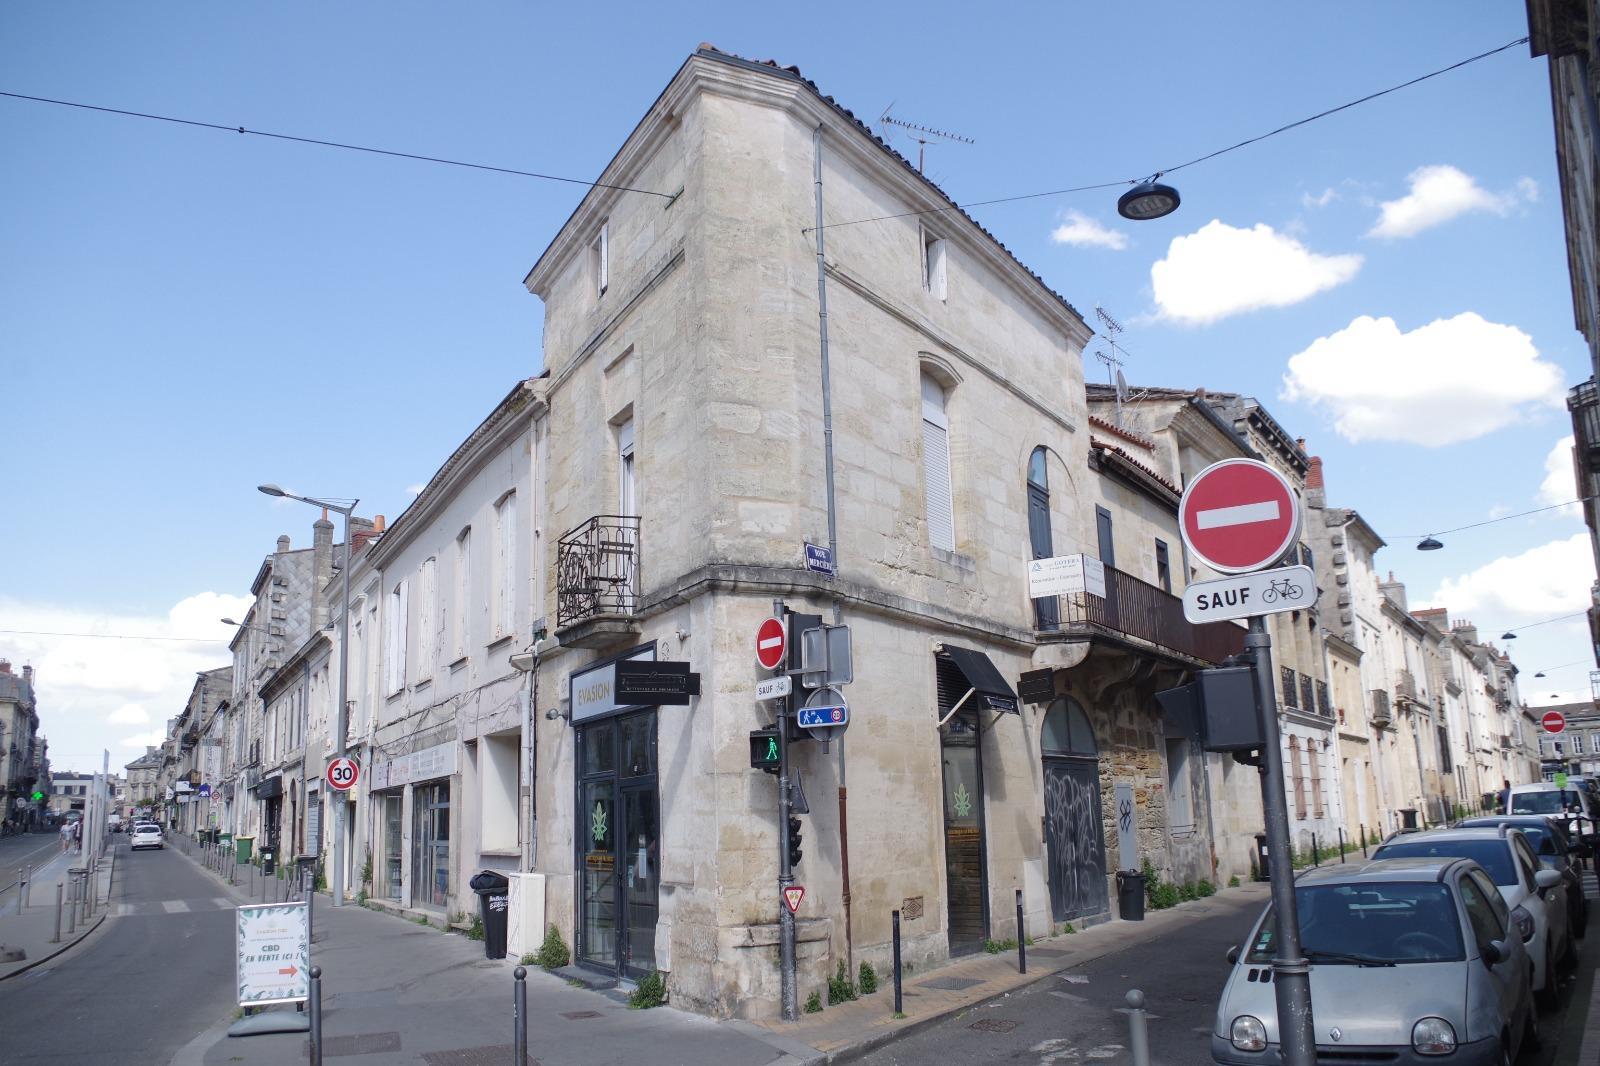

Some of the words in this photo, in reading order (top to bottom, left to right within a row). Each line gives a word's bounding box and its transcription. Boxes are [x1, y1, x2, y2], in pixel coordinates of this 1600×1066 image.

[814, 549, 826, 559] RUE
[1197, 587, 1250, 611] SAUF
[578, 682, 610, 706] EVASION
[758, 685, 773, 696] SAUF
[334, 767, 352, 781] 30
[246, 955, 255, 963] EN
[257, 953, 280, 962] VENTE
[282, 953, 293, 961] ICI
